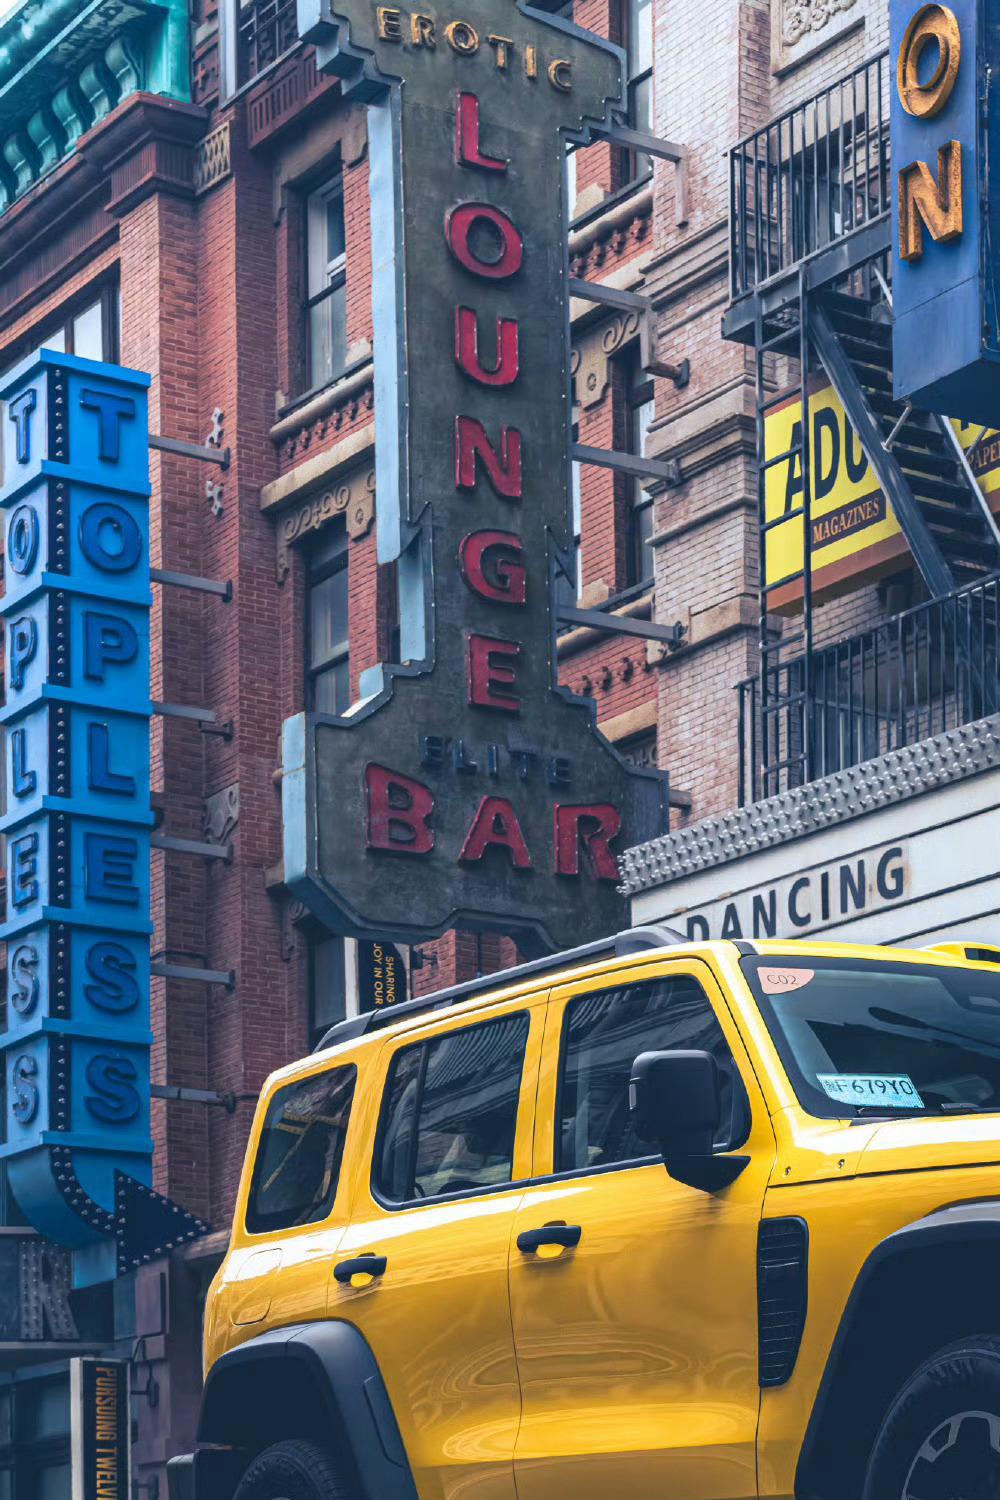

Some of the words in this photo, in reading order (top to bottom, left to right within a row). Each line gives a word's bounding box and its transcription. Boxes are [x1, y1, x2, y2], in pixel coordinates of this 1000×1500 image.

[376, 6, 573, 93] EROTIC
[444, 89, 527, 711] LOUNGE
[812, 497, 881, 545] MAGAZINES
[7, 387, 42, 1125] TOPLESS
[78, 387, 144, 1124] TOPLESS
[421, 735, 572, 786] ELITE
[364, 761, 623, 882] BAR
[686, 846, 904, 942] DANCING
[373, 943, 383, 965] JOY
[373, 967, 384, 979] IN
[385, 956, 396, 1004] SHARING
[374, 981, 384, 1006] OUR
[95, 1366, 118, 1442] PURSUING
